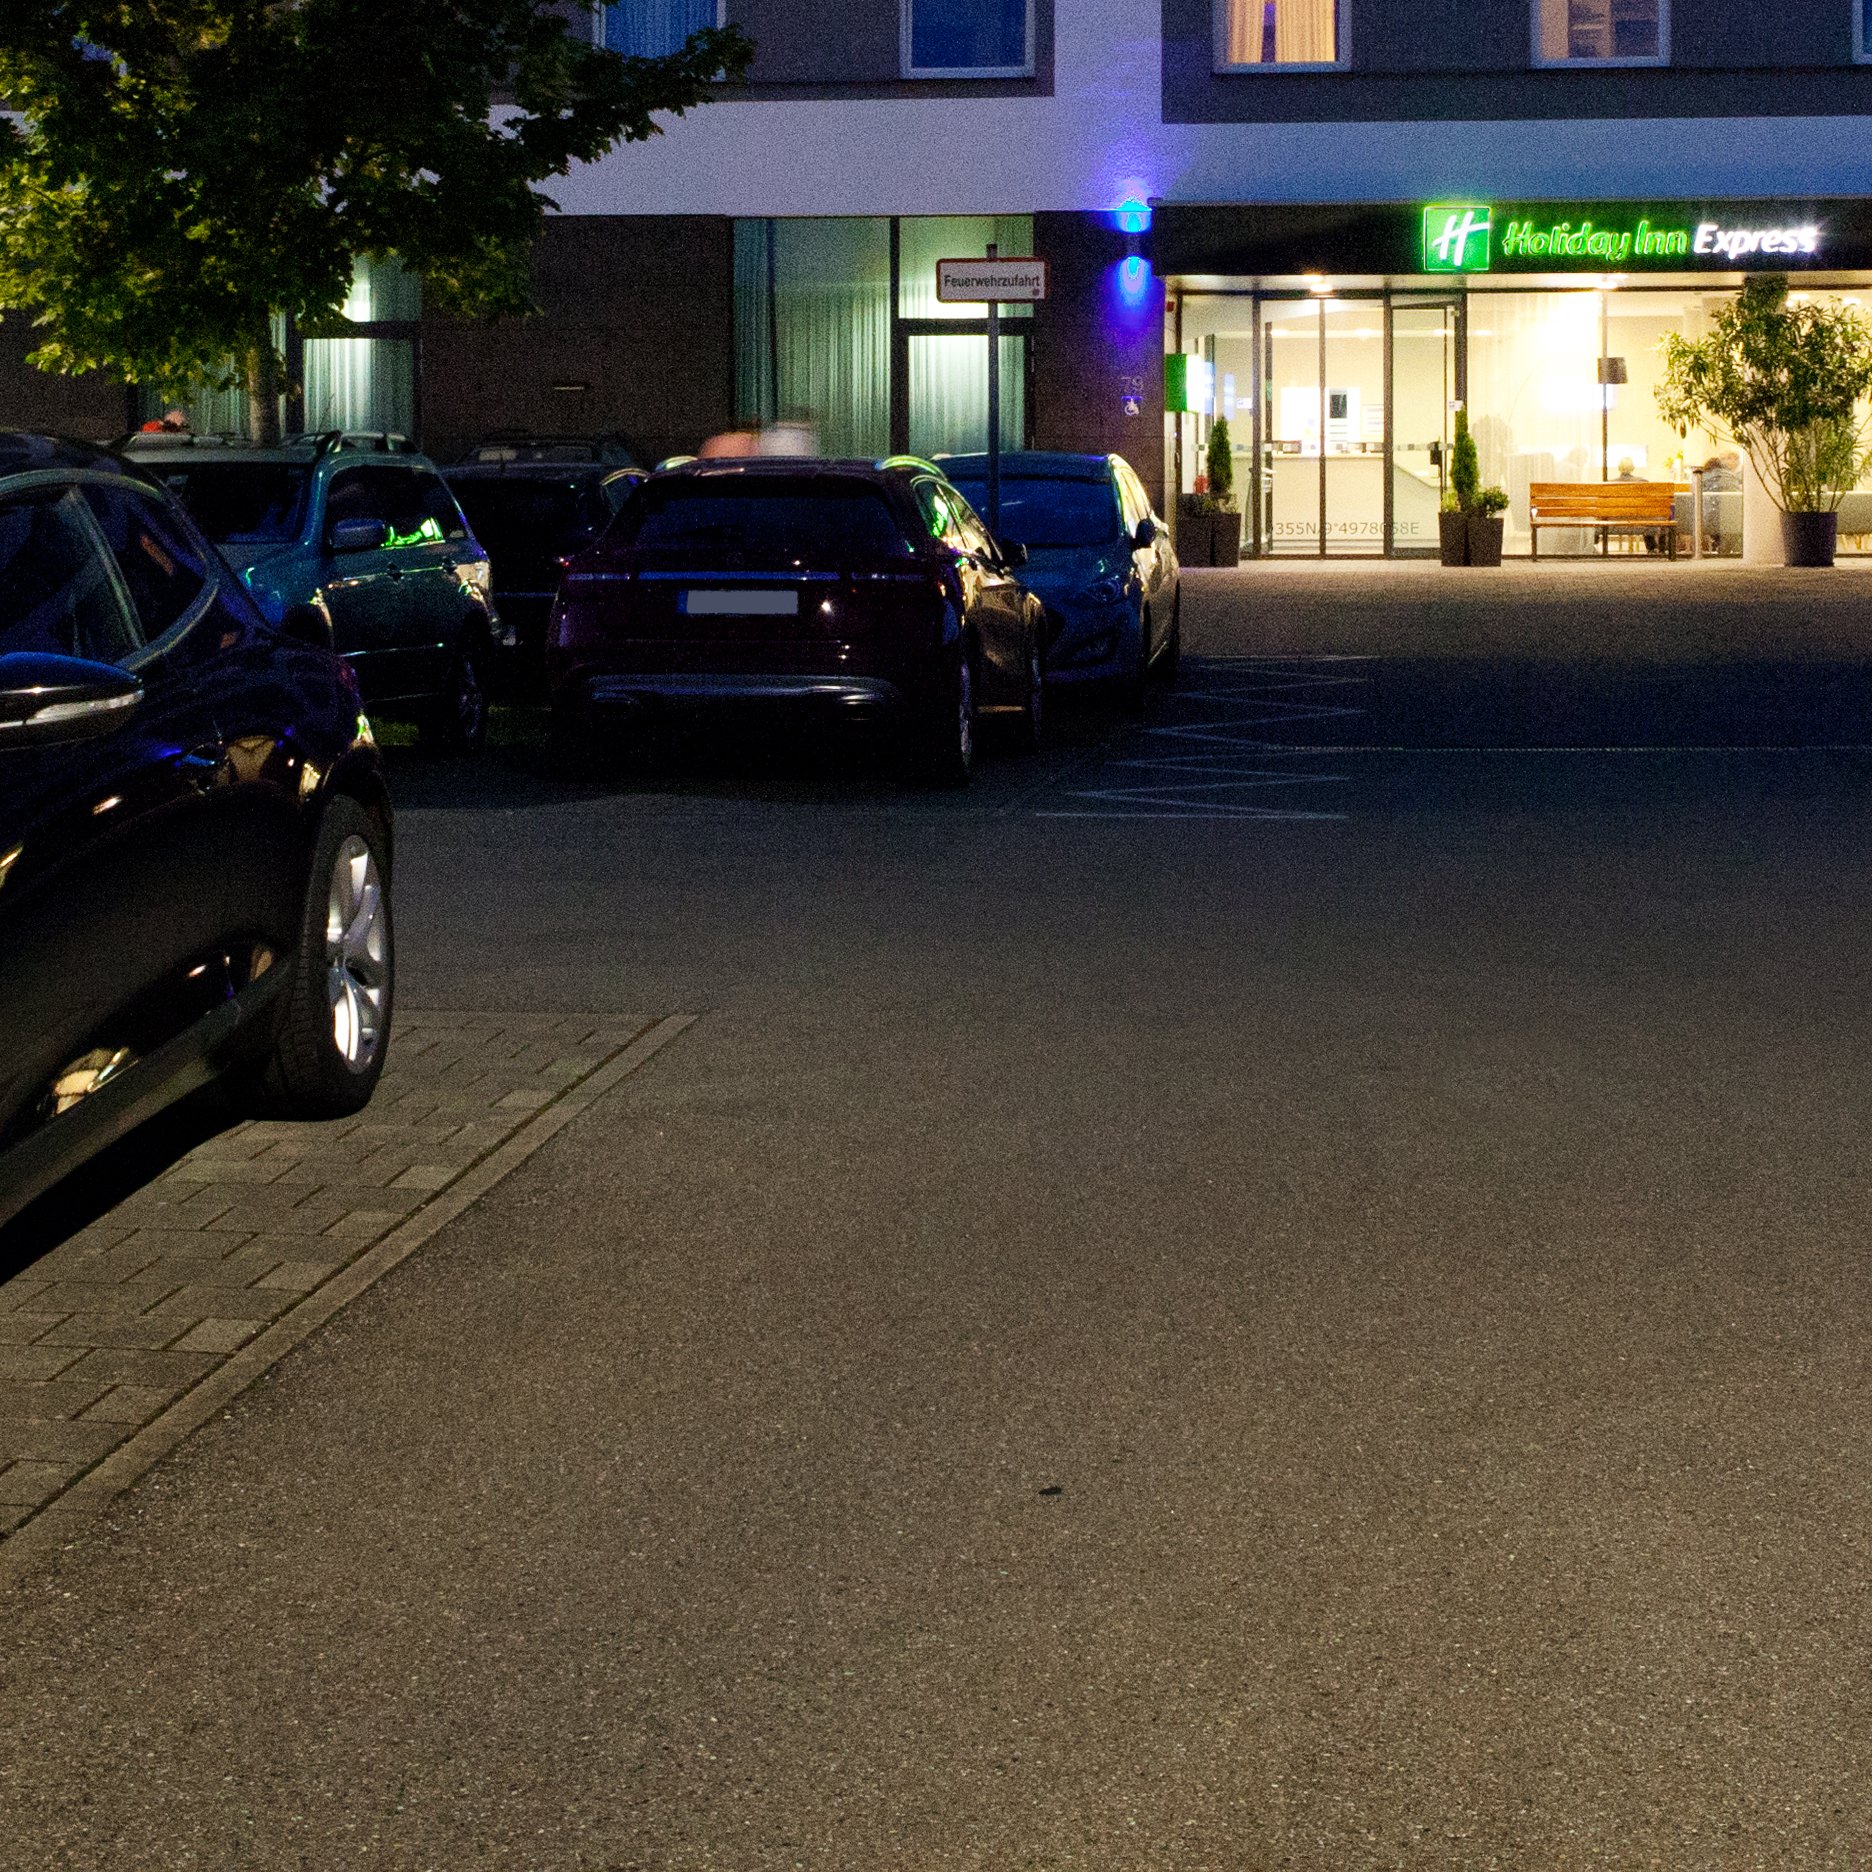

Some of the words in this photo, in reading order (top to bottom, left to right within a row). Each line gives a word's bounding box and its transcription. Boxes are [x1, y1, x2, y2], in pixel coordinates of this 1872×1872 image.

[1503, 220, 1630, 261] Holiday
[1635, 220, 1688, 255] Inn
[1693, 223, 1817, 260] Express
[943, 273, 1041, 287] Feuerwehrzufahrt
